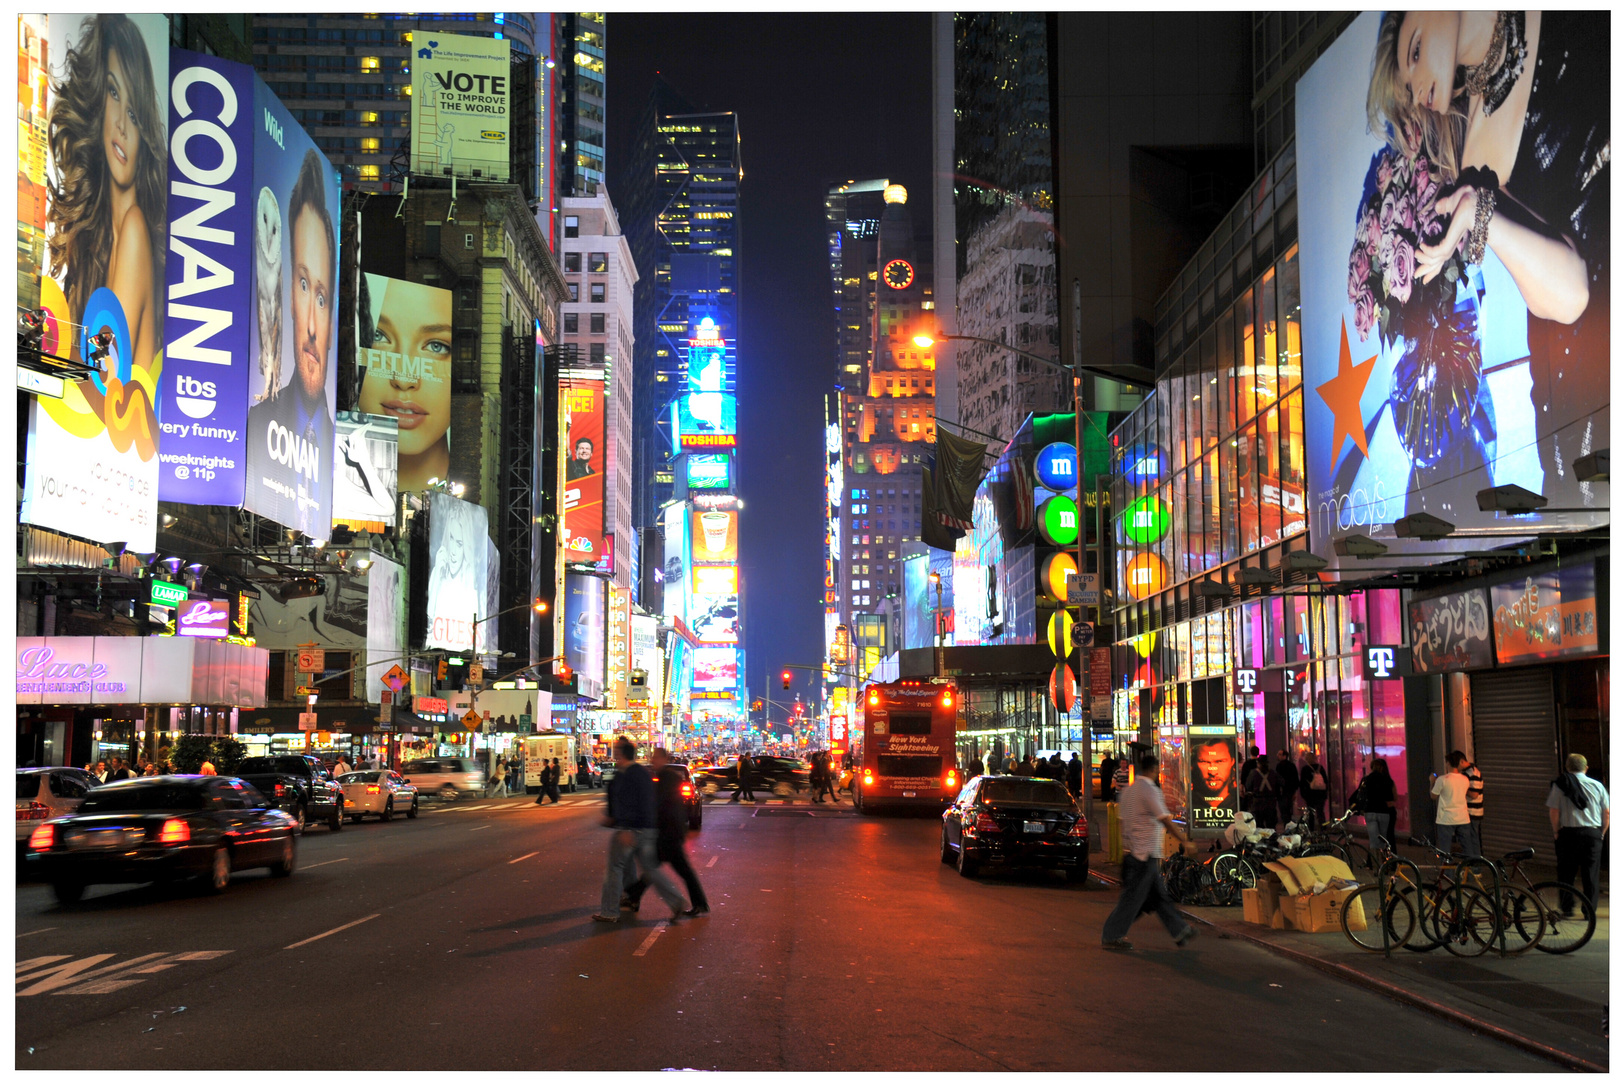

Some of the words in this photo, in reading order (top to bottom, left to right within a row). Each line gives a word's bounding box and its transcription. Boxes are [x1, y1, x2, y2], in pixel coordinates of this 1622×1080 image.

[454, 51, 487, 59] Improvement
[434, 70, 506, 96] VOTE
[440, 92, 454, 100] TO
[457, 94, 506, 105] IMPROVE
[440, 101, 462, 111] THE
[464, 103, 506, 115] WORLD
[264, 107, 286, 151] Wild.
[166, 65, 239, 366] CONAN
[689, 339, 725, 347] TOSHIBA
[367, 348, 401, 371] FIT
[402, 354, 434, 377] ME
[176, 374, 217, 399] tbs
[680, 435, 736, 446] TOSHIBA
[267, 419, 319, 484] CONAN
[159, 452, 235, 470] weeknights
[1051, 458, 1072, 475] m
[175, 465, 190, 480] @
[193, 467, 216, 482] 11p
[1318, 475, 1387, 539] macy's
[1060, 511, 1076, 528] m
[1071, 575, 1095, 583] NYPD
[154, 587, 185, 601] LAMAR
[181, 601, 228, 625] Lace
[433, 616, 482, 648] GUESS
[616, 596, 626, 682] PALACE
[17, 648, 107, 680] Lace
[1368, 648, 1394, 677] T
[95, 682, 127, 692] CLUB
[1237, 669, 1257, 693] T
[244, 726, 275, 734] SMILER'S
[888, 735, 908, 743] New
[888, 743, 940, 754] Sightseeing
[1193, 808, 1235, 819] THOR
